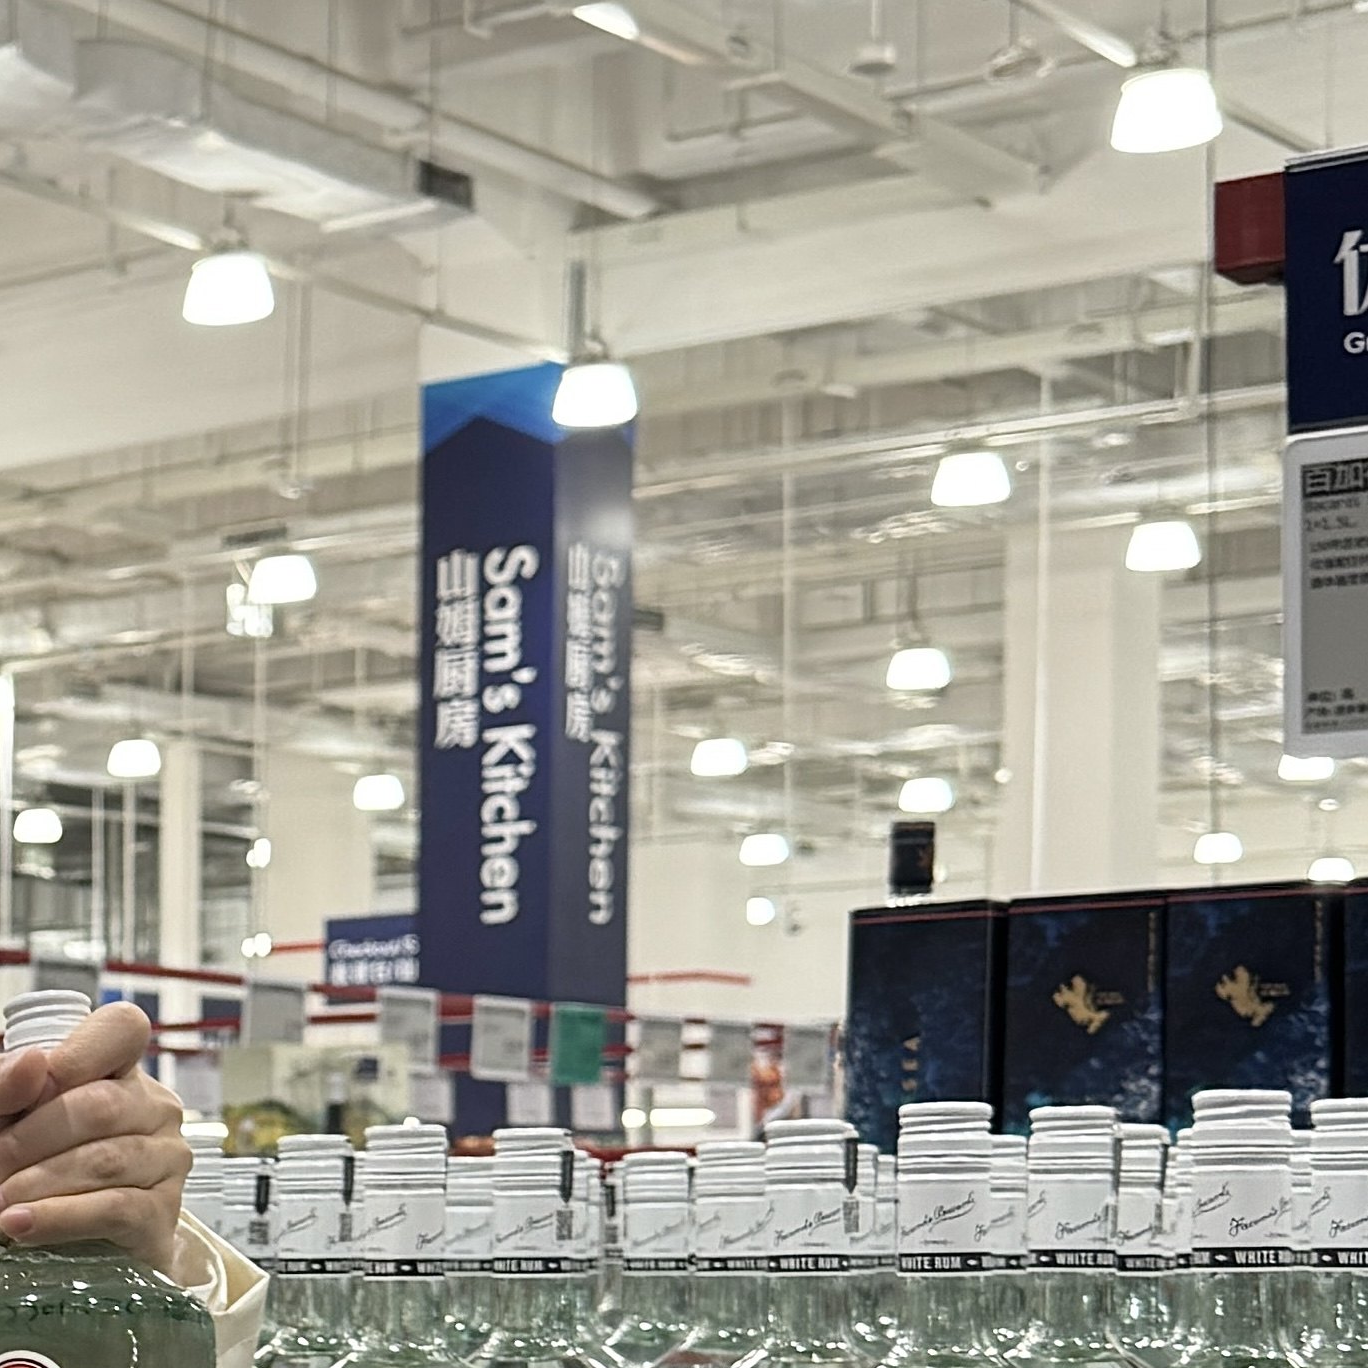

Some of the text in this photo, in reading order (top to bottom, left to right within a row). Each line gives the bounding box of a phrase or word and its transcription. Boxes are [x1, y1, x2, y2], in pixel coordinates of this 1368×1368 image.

[479, 543, 538, 926] Sam's Kitchen
[588, 728, 623, 926] Kitchen
